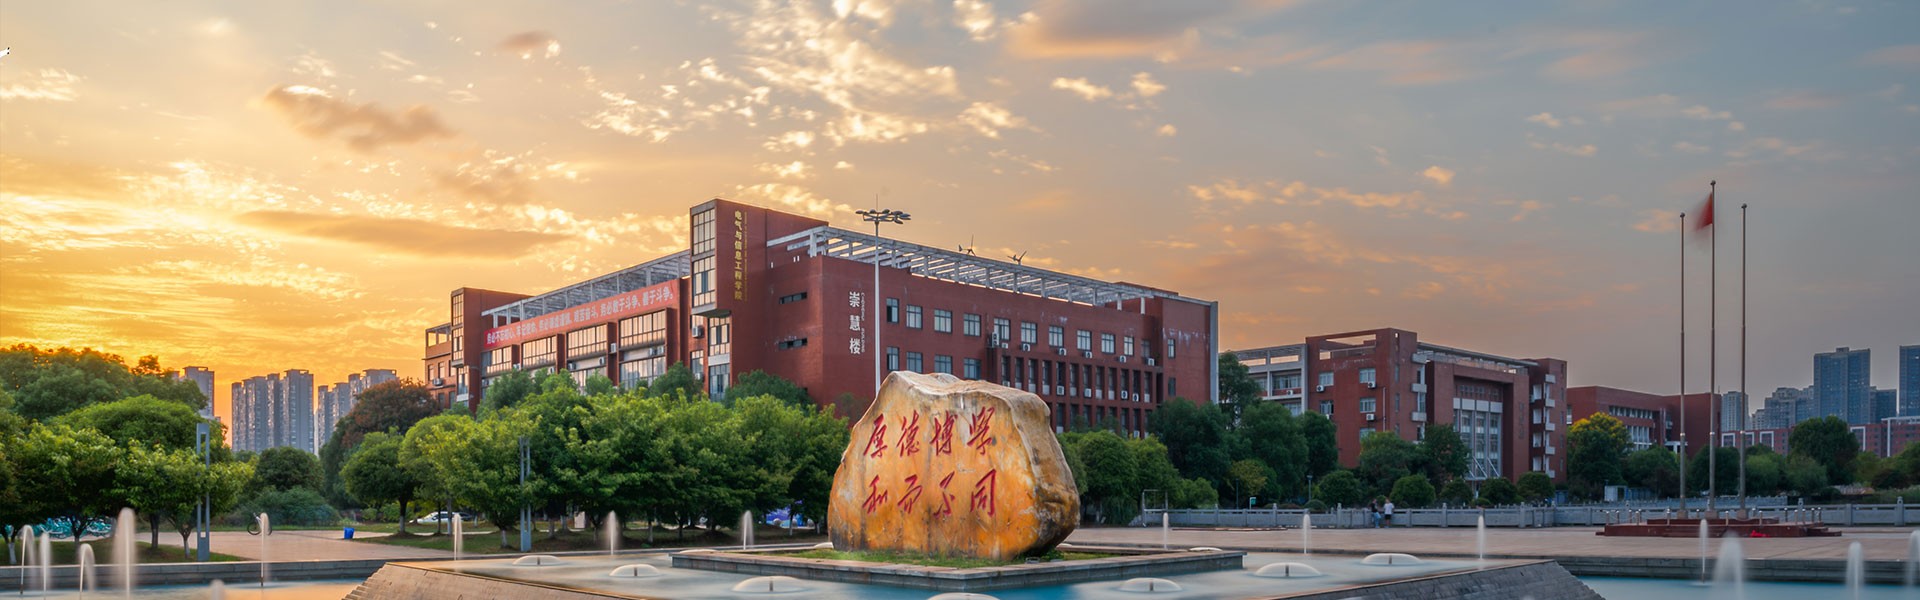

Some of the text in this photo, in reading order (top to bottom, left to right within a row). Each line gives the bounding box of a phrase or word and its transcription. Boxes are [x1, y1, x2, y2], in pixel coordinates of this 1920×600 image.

[734, 210, 743, 300] 电气与信息工程学院
[849, 291, 861, 355] 崇慧楼
[862, 468, 997, 519] 和而不同
